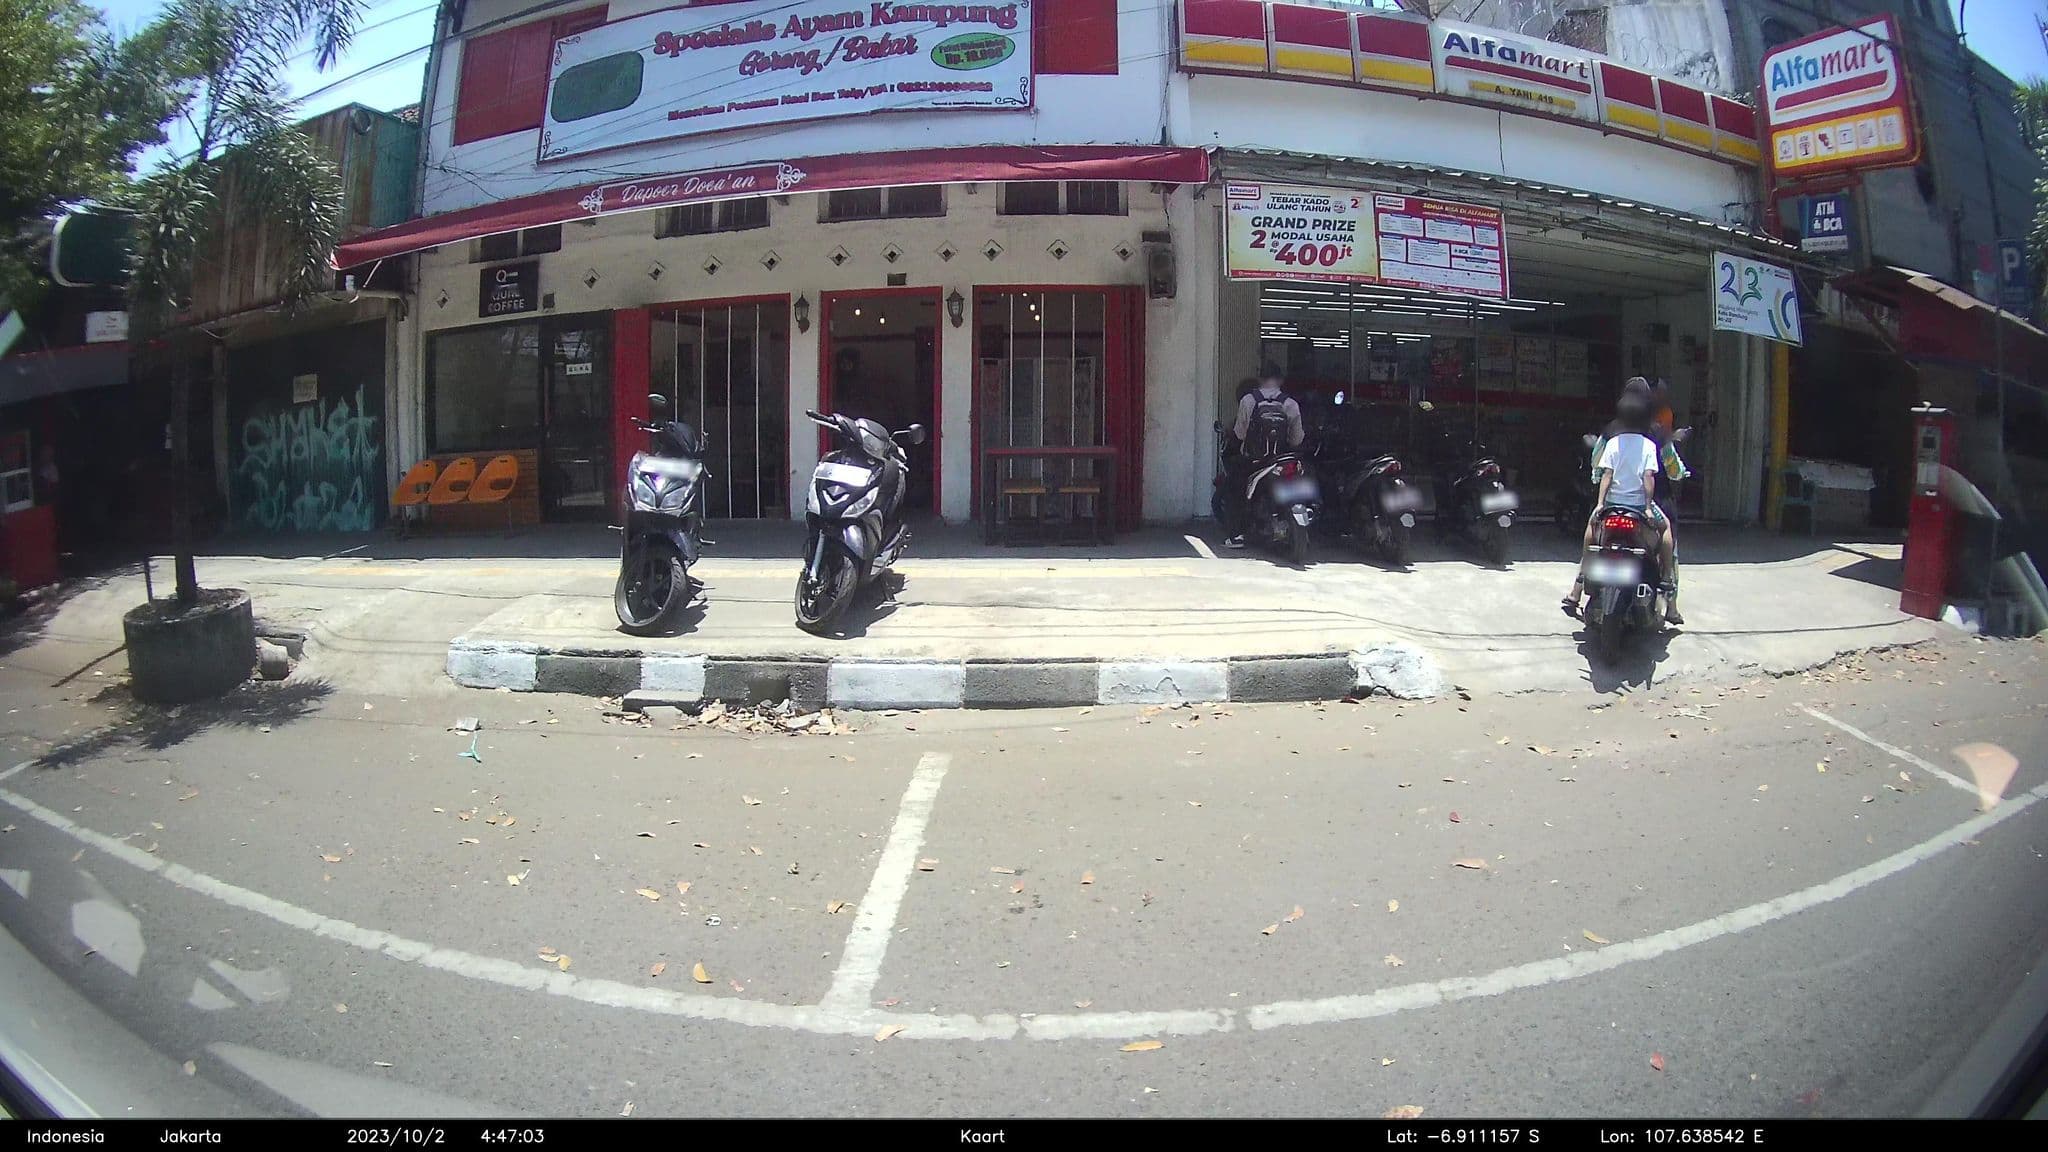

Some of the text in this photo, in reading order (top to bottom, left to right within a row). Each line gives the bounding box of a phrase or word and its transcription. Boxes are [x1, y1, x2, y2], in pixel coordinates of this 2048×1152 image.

[780, 11, 864, 42] Ayam
[870, 1, 1018, 30] Kampung
[739, 50, 823, 75] Goreng
[843, 32, 918, 62] Bakar
[1443, 32, 1589, 79] Alfamart
[1771, 40, 1885, 91] Alfamart
[621, 183, 679, 203] Dapoer
[1271, 196, 1302, 204] TEBAR
[1266, 203, 1299, 211] ULANG
[1301, 205, 1331, 213] TAHUN
[1422, 202, 1444, 211] SEMUA
[1467, 209, 1498, 219] ALFAMART
[1816, 200, 1835, 216] ATM
[1251, 216, 1356, 231] GRAND PRIZE
[1823, 216, 1843, 231] BCA
[1249, 230, 1354, 249] 2 MODAL USAHA
[2002, 247, 2020, 281] P
